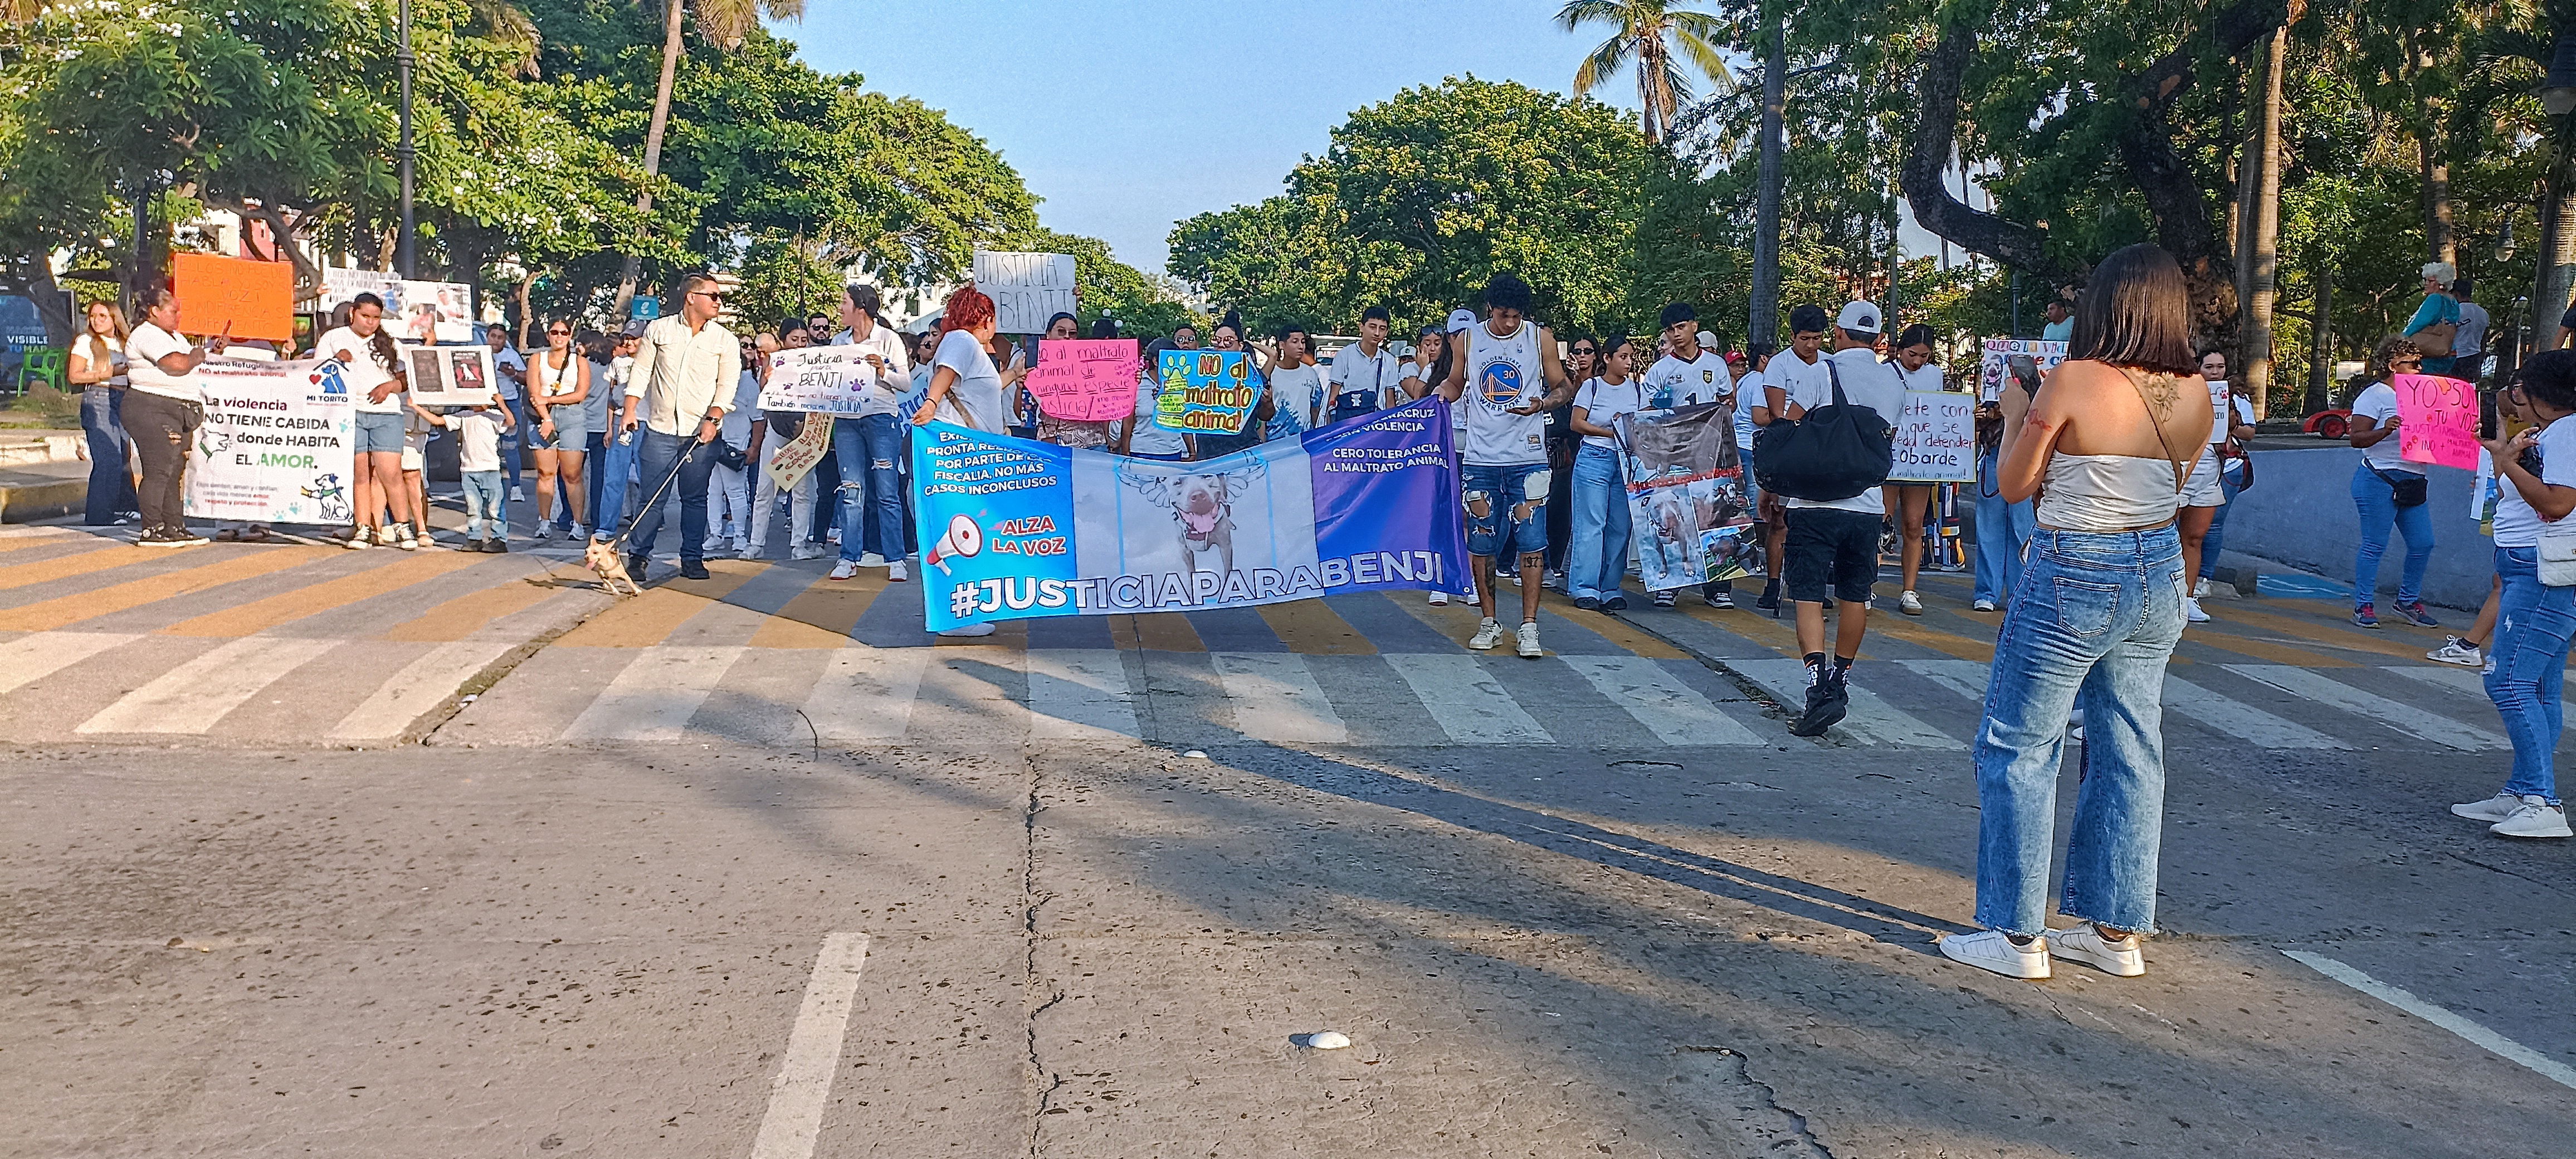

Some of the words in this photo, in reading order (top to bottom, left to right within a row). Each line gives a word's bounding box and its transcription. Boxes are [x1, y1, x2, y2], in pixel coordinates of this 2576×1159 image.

[180, 256, 223, 274] ELLOS
[230, 263, 243, 275] NO
[977, 254, 1058, 286] JUSTICIA
[7, 335, 48, 344] VISIBLE
[797, 352, 842, 367] Justicia
[1057, 345, 1066, 359] al
[1077, 344, 1128, 359] maltrato
[809, 364, 832, 373] para
[1035, 363, 1074, 378] animal
[1081, 362, 1095, 375] de
[1199, 354, 1223, 376] NO
[1230, 354, 1247, 379] al
[1479, 356, 1502, 370] GOLDEN
[1506, 357, 1523, 369] STATE
[799, 372, 842, 389] BENJI
[1503, 371, 1515, 379] 30
[1036, 381, 1077, 397] ninguna
[1084, 379, 1129, 392] especie
[1184, 380, 1253, 408] maltrato
[2405, 379, 2437, 408] YO
[204, 396, 219, 406] La
[223, 397, 287, 411] violencia
[830, 400, 861, 413] JUSTICIA
[1941, 405, 1968, 417] con
[204, 413, 225, 424] NO
[227, 413, 272, 427] TIENE
[275, 417, 330, 430] CABIDA
[1362, 421, 1425, 432] VIOLENCIA
[2434, 410, 2448, 427] TU
[1910, 422, 1930, 434] que
[1942, 422, 1960, 434] se
[237, 432, 282, 445] donde
[286, 435, 340, 447] HABITA
[1925, 433, 1975, 450] defender
[926, 443, 975, 456] PRONTA
[1333, 449, 1365, 458] CERO
[1367, 444, 1441, 459] TOLERANCIA
[236, 454, 252, 465] EL
[256, 453, 318, 469] AMOR.
[936, 459, 962, 469] POR
[965, 454, 1003, 467] PARTE
[1324, 463, 1339, 472] AL
[1341, 462, 1403, 473] MALTRATO
[1407, 456, 1449, 469] ANIMAL
[934, 470, 992, 482] FISCALIA,
[995, 467, 1013, 478] NO
[1016, 462, 1044, 474] MÁS
[1897, 468, 1930, 478] maltrato
[1934, 468, 1967, 480] animal!
[924, 484, 965, 496] CASOS
[968, 476, 1057, 495] INCONCLUSOS
[1001, 515, 1056, 535] ALZA
[993, 537, 1020, 553] LA
[1022, 537, 1066, 556] VOZ
[951, 550, 1444, 619] #JUSTICIAPARABENJI
